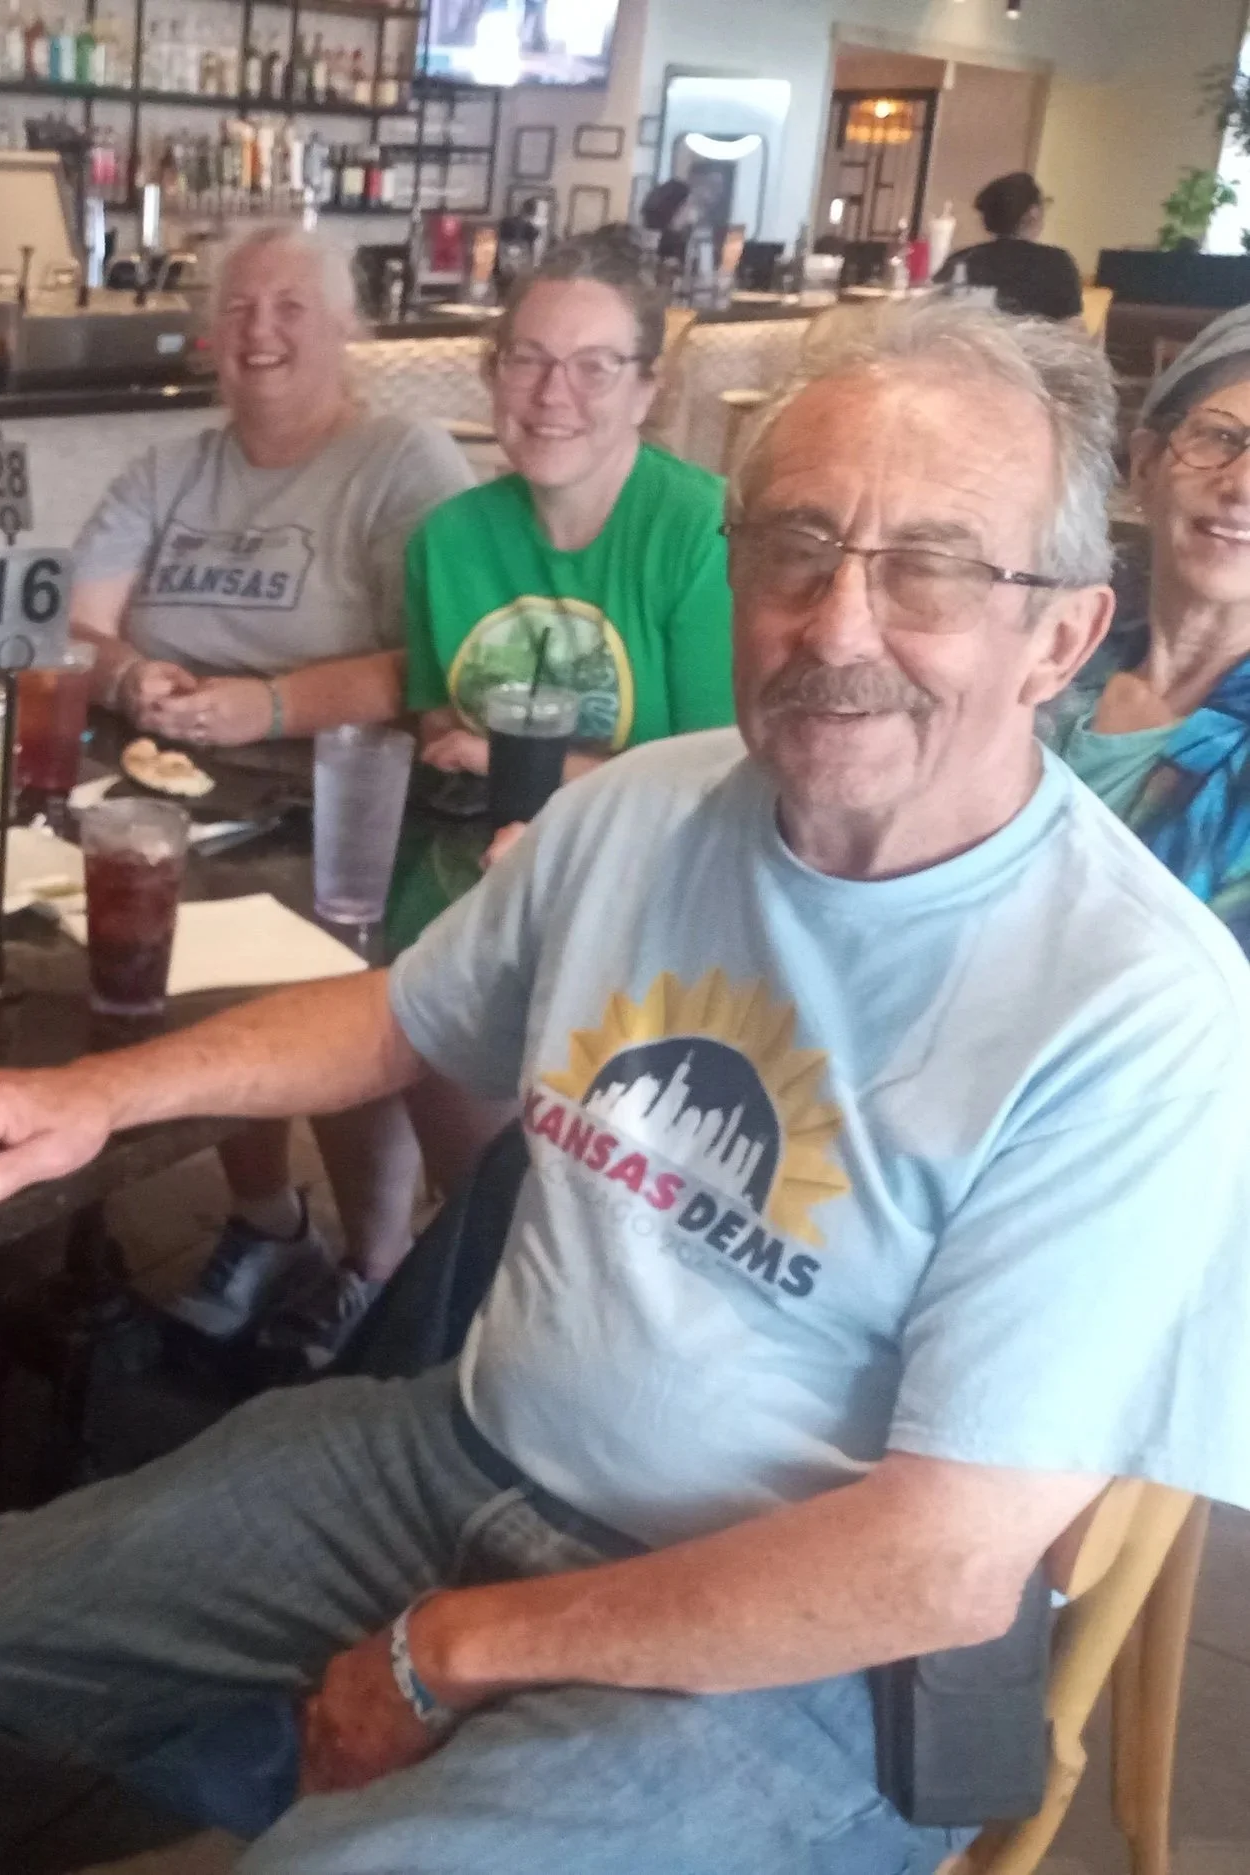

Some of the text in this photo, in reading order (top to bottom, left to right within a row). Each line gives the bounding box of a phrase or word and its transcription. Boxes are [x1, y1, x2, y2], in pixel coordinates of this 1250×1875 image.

[156, 564, 290, 600] KANSAS
[524, 1084, 686, 1211] KANSAS
[677, 1191, 822, 1298] DEMS
